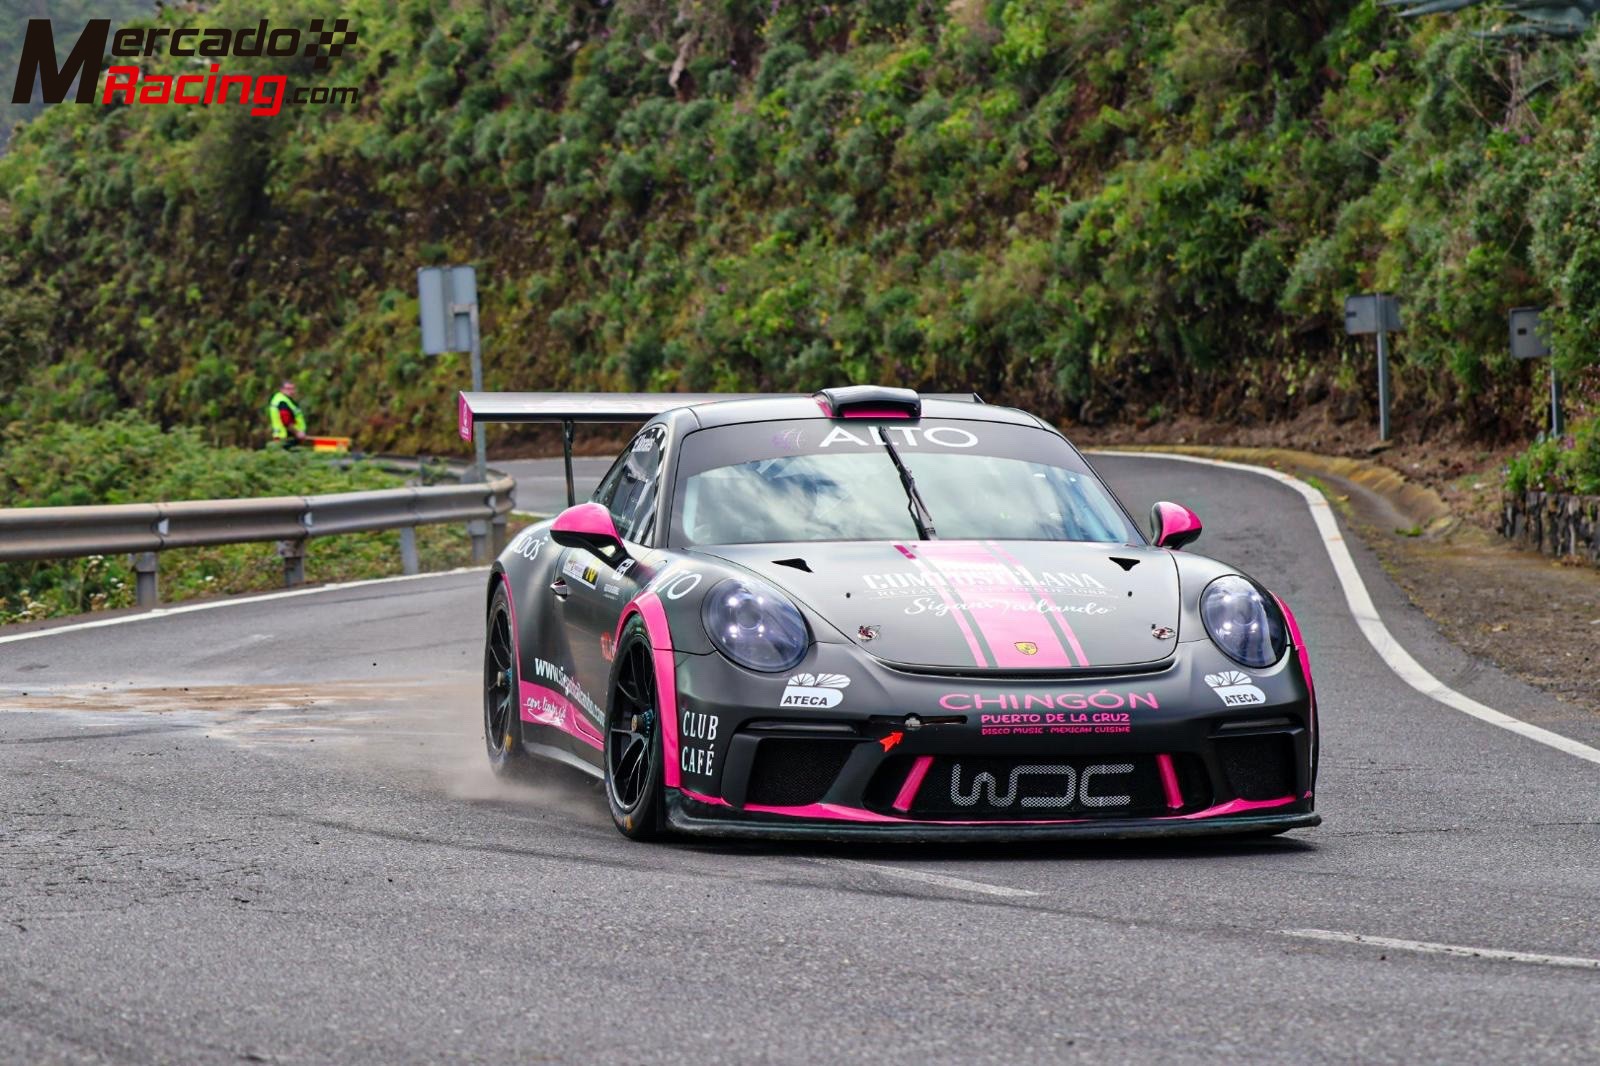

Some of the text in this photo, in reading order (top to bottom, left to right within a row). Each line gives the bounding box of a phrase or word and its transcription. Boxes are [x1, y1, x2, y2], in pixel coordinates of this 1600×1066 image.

[819, 425, 979, 448] ALTO
[783, 695, 828, 706] ATECA
[938, 689, 1160, 710] CHINGÓN
[1224, 693, 1260, 705] ATECA
[682, 710, 719, 741] CLUB
[980, 713, 1130, 724] PUERTO DE LA CRUZ
[981, 728, 1010, 736] DISCO
[1013, 727, 1044, 735] MUSIC
[681, 743, 715, 777] CAFÉ
